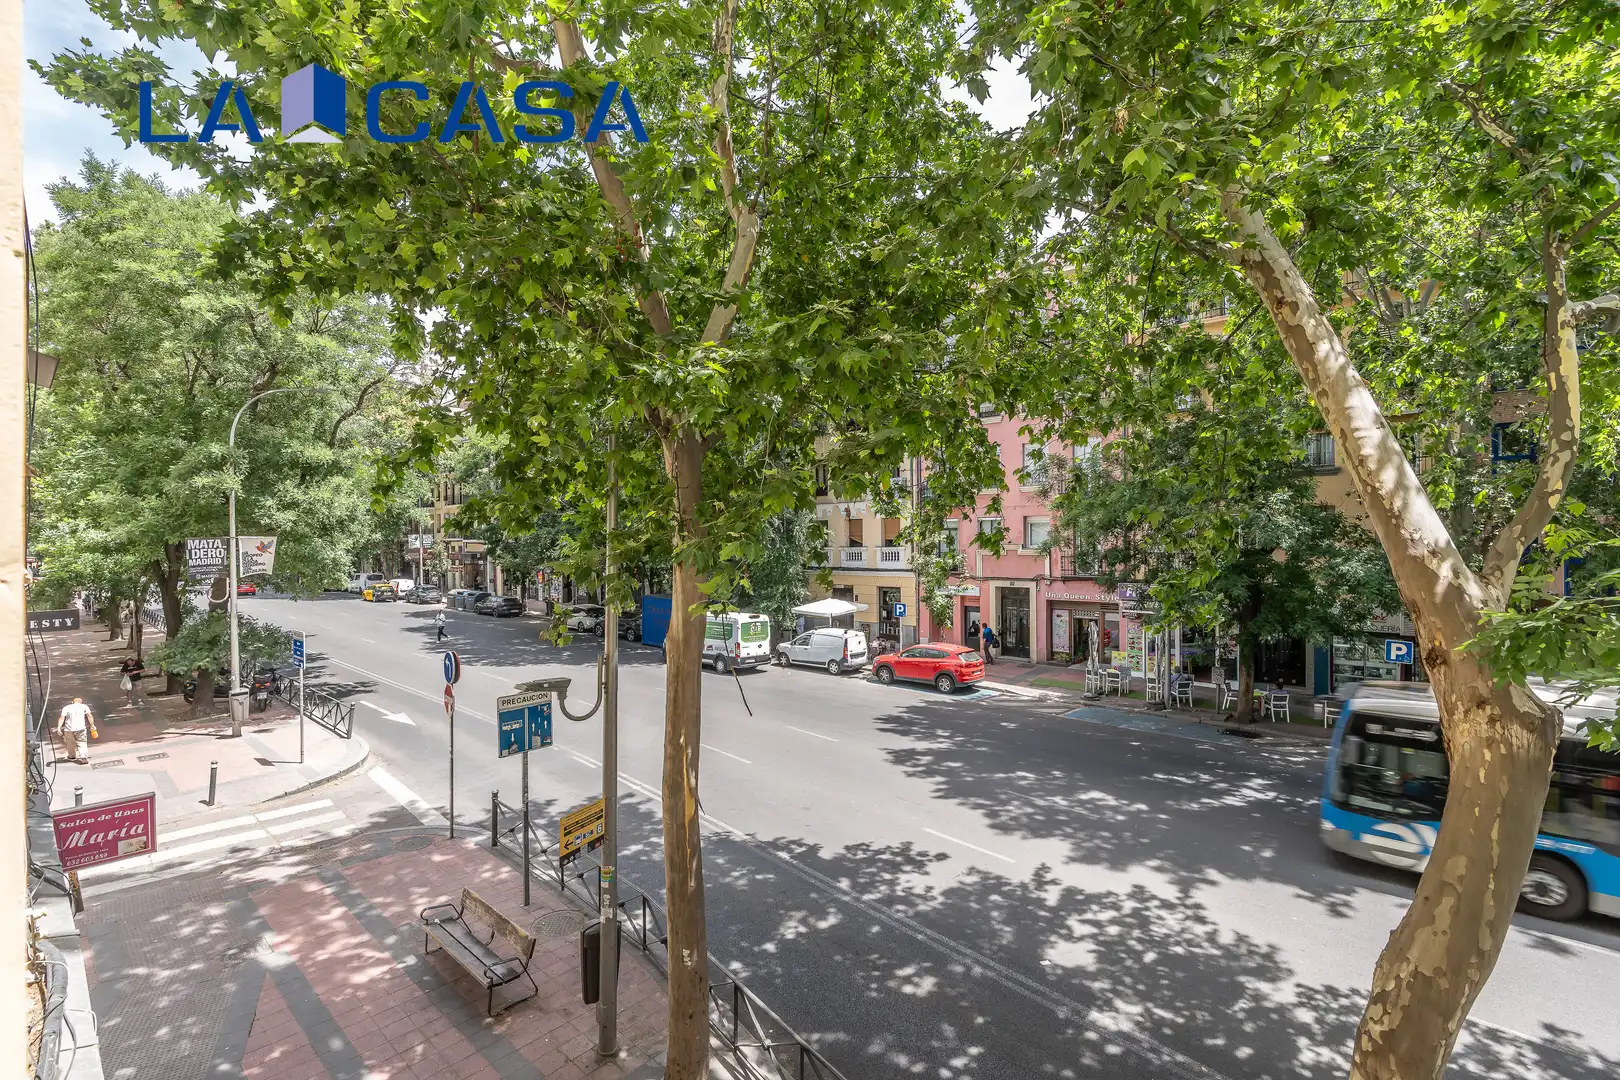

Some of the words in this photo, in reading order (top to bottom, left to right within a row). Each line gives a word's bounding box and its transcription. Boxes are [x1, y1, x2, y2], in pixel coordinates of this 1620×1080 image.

[191, 548, 225, 559] DERO
[189, 558, 222, 567] MADRID
[1045, 591, 1061, 599] Una
[1063, 592, 1091, 600] Queen
[1094, 593, 1120, 602] Style
[896, 604, 904, 615] P
[1390, 642, 1408, 660] P
[59, 818, 95, 829] Salón
[114, 807, 145, 818] Uñas
[61, 821, 146, 849] María
